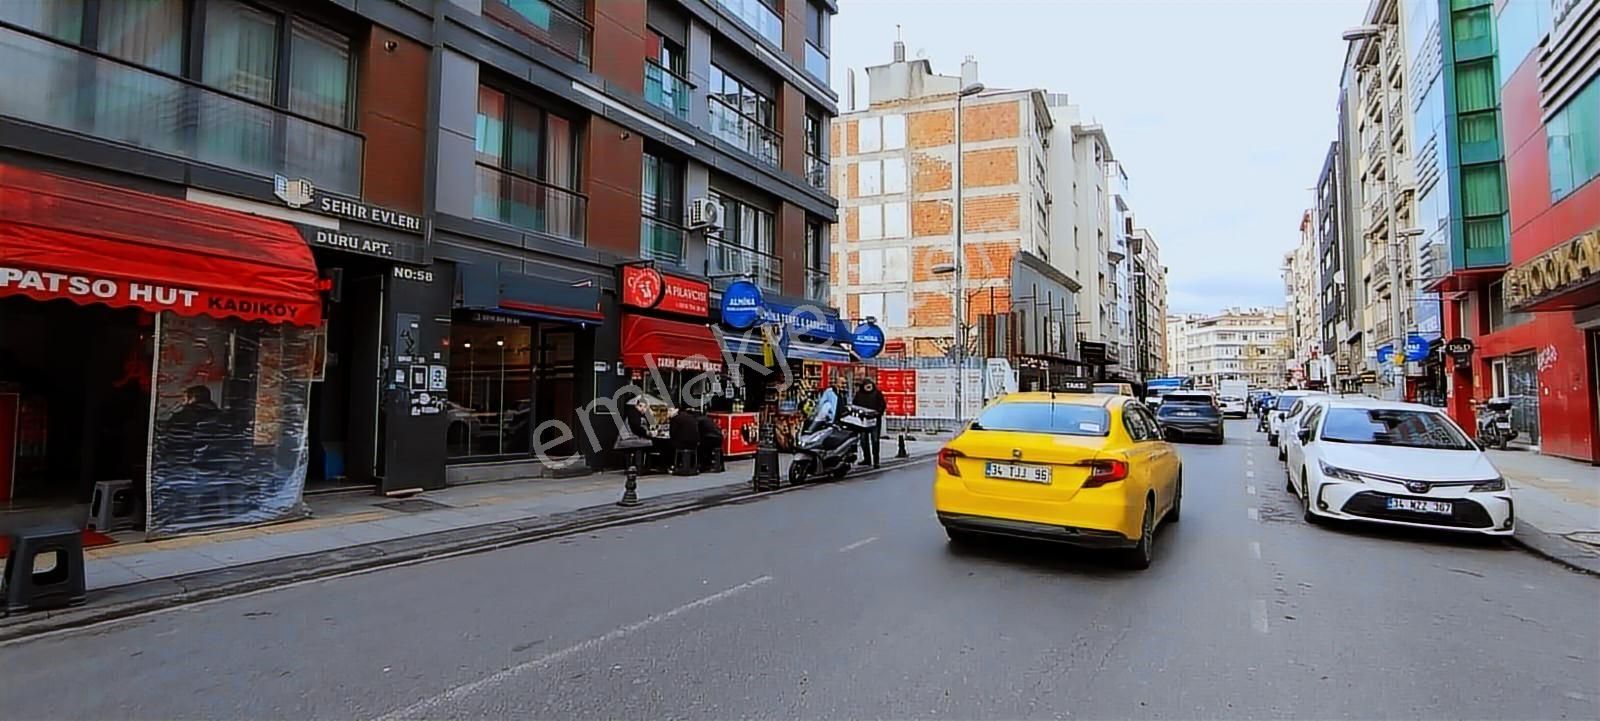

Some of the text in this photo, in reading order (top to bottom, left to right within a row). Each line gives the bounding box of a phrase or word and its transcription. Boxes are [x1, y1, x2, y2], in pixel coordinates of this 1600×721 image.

[317, 231, 393, 255] DURU APT.
[0, 267, 118, 298] PATSO
[130, 283, 199, 307] HUT
[991, 464, 1003, 476] 34
